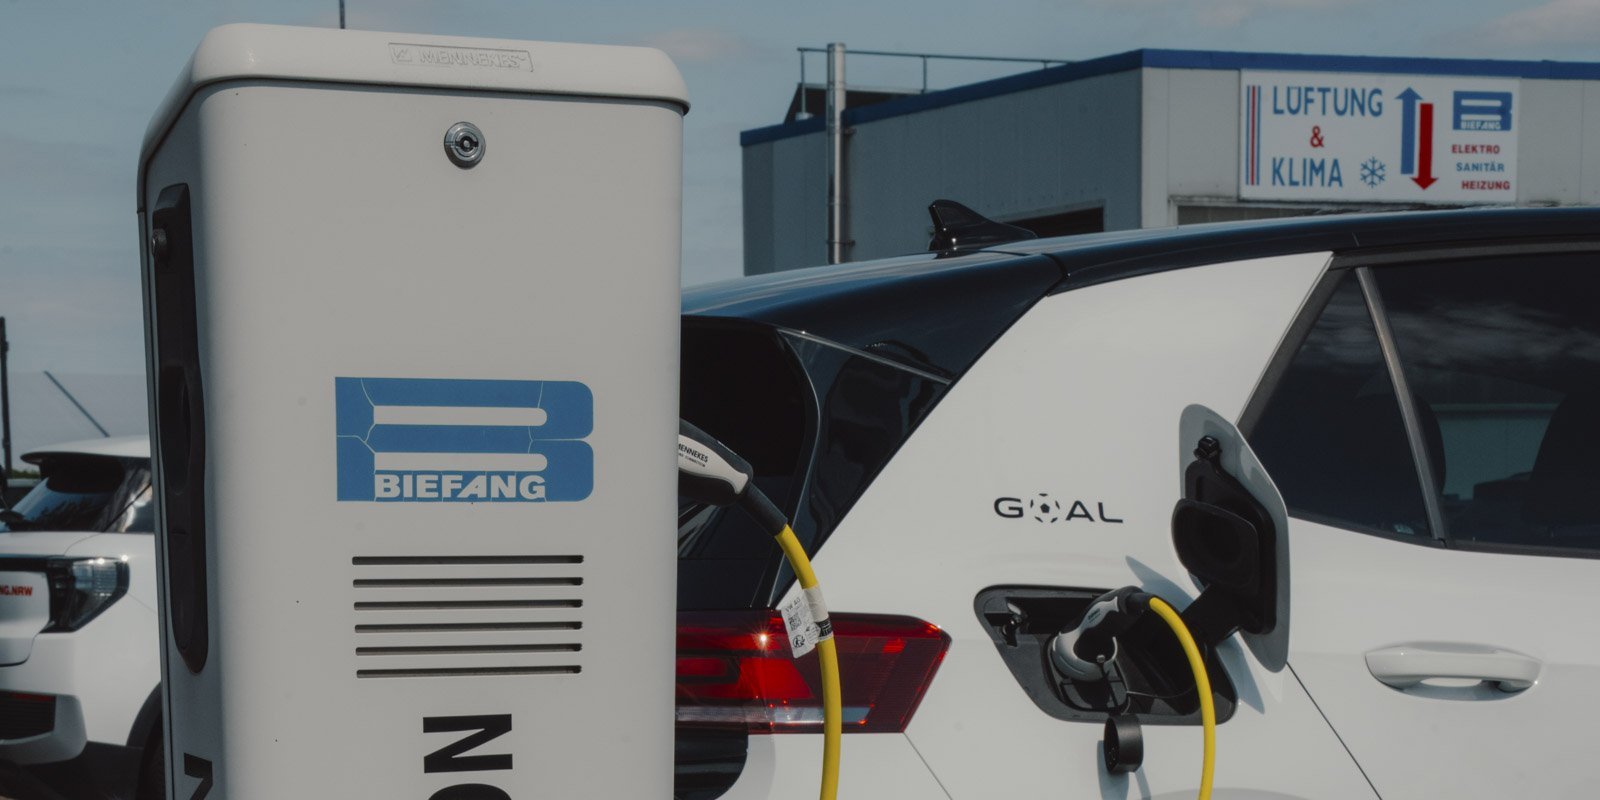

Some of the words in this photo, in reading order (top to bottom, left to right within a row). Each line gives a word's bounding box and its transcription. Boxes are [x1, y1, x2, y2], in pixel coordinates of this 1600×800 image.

[1272, 85, 1383, 117] LÜFTUNG
[1460, 120, 1502, 130] BIEFANG
[1309, 125, 1325, 148] &
[1451, 144, 1500, 154] ELEKTRO
[1271, 157, 1344, 188] KLIMA
[1456, 161, 1505, 172] SANITÄR
[1461, 180, 1511, 190] HEIZUNG
[374, 474, 546, 499] BIEFANG
